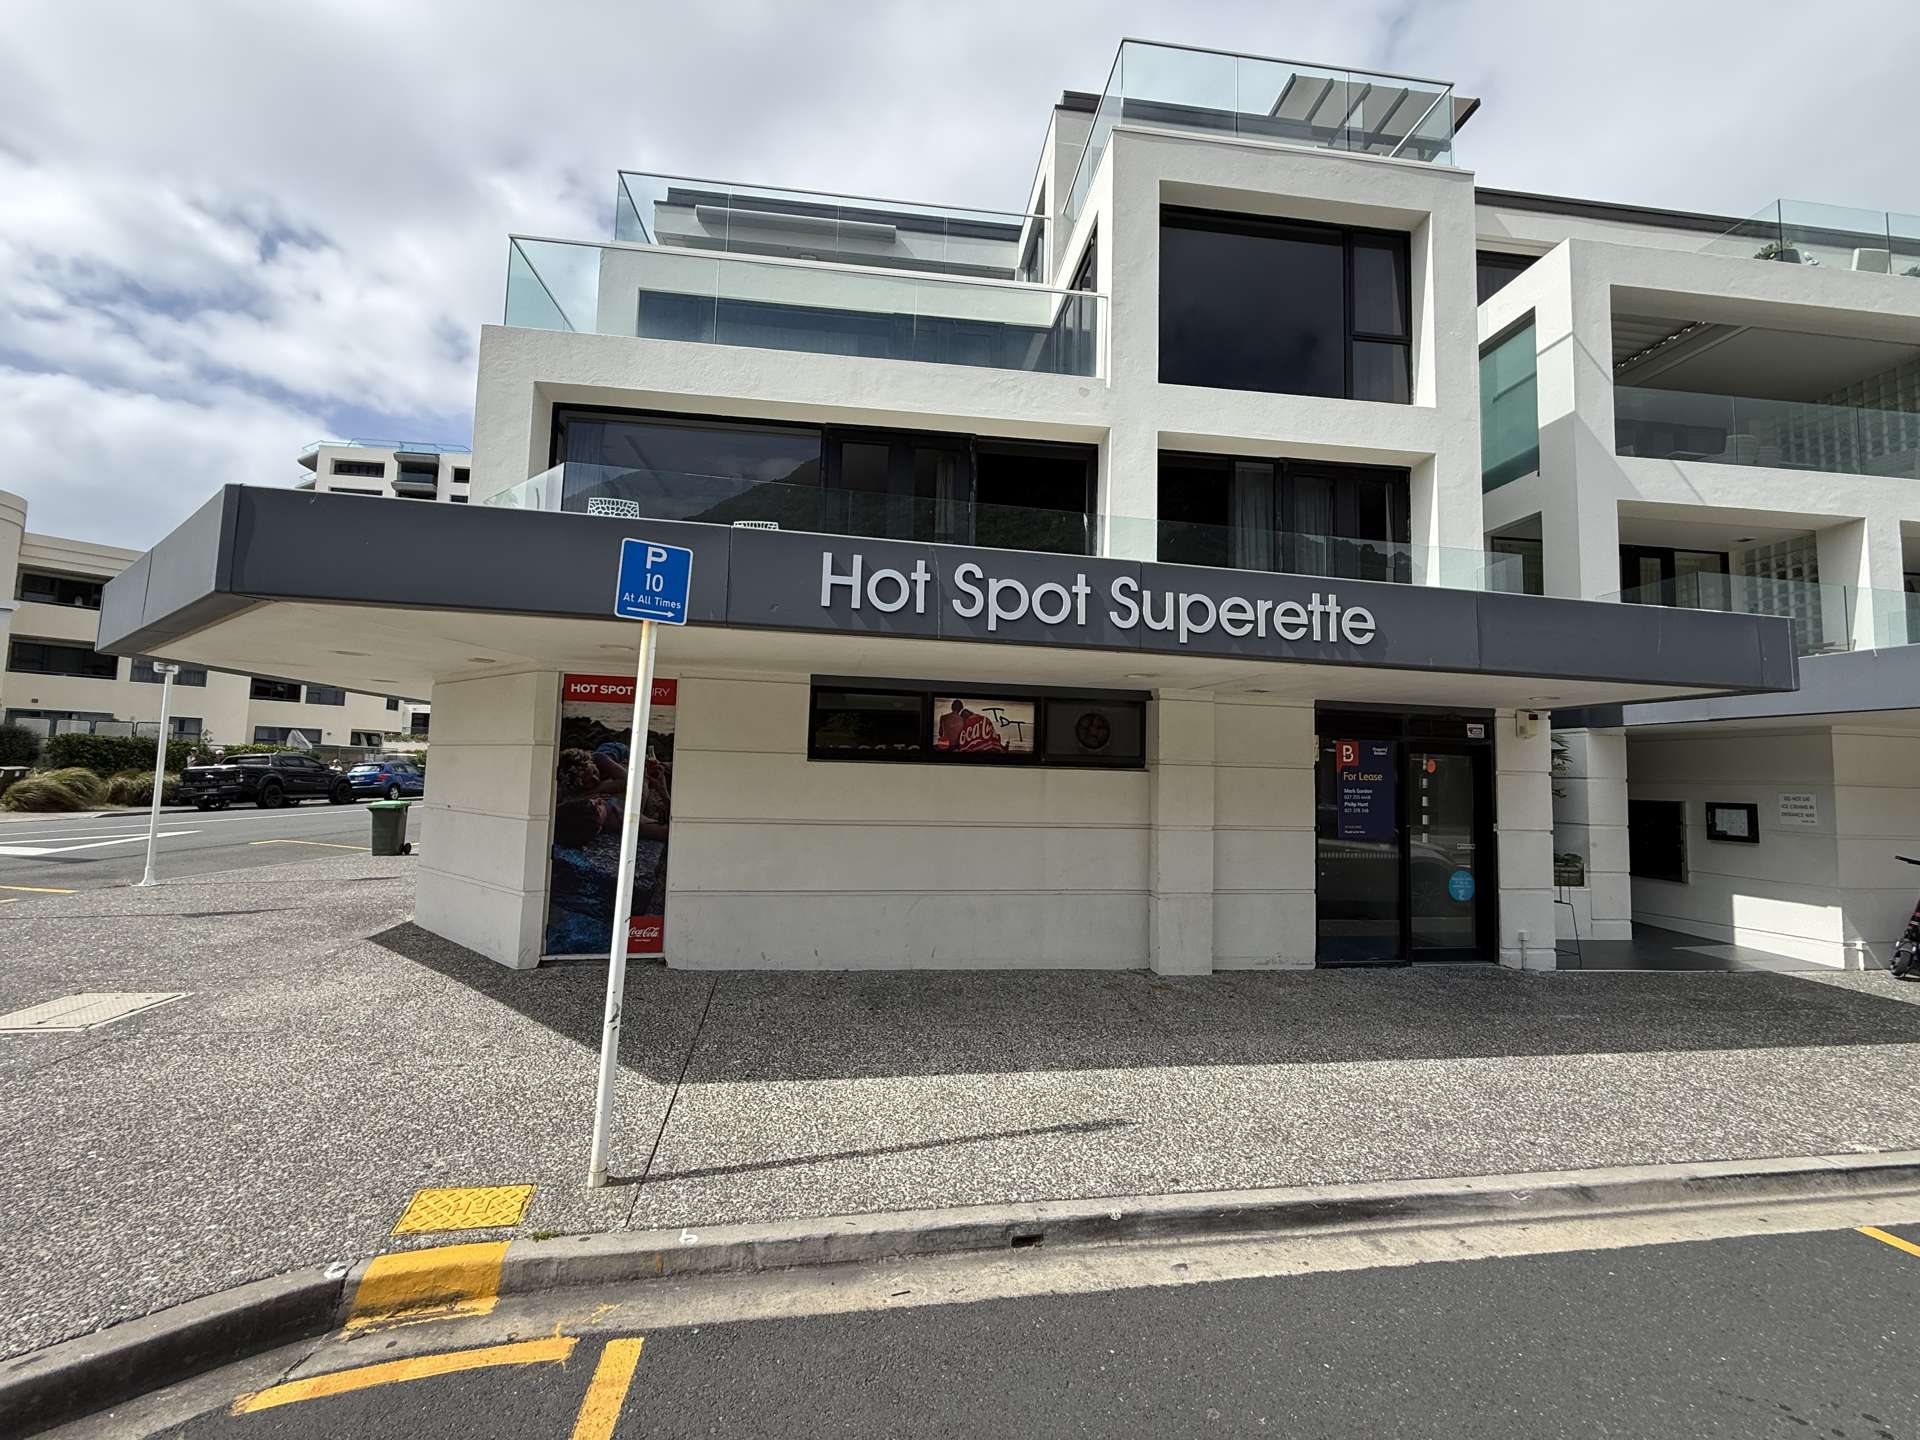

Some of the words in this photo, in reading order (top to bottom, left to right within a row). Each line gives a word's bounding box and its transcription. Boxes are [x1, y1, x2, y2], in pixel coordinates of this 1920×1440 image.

[646, 546, 668, 569] P
[645, 573, 664, 592] 10
[623, 592, 634, 602] At
[638, 594, 651, 605] All
[654, 596, 681, 609] Times
[820, 551, 931, 614] Hot
[952, 562, 1092, 631] Spot
[1109, 576, 1376, 645] Superette
[570, 683, 598, 694] HOT
[600, 685, 634, 695] SPOT
[1343, 771, 1356, 781] For
[1359, 771, 1383, 781] Lease
